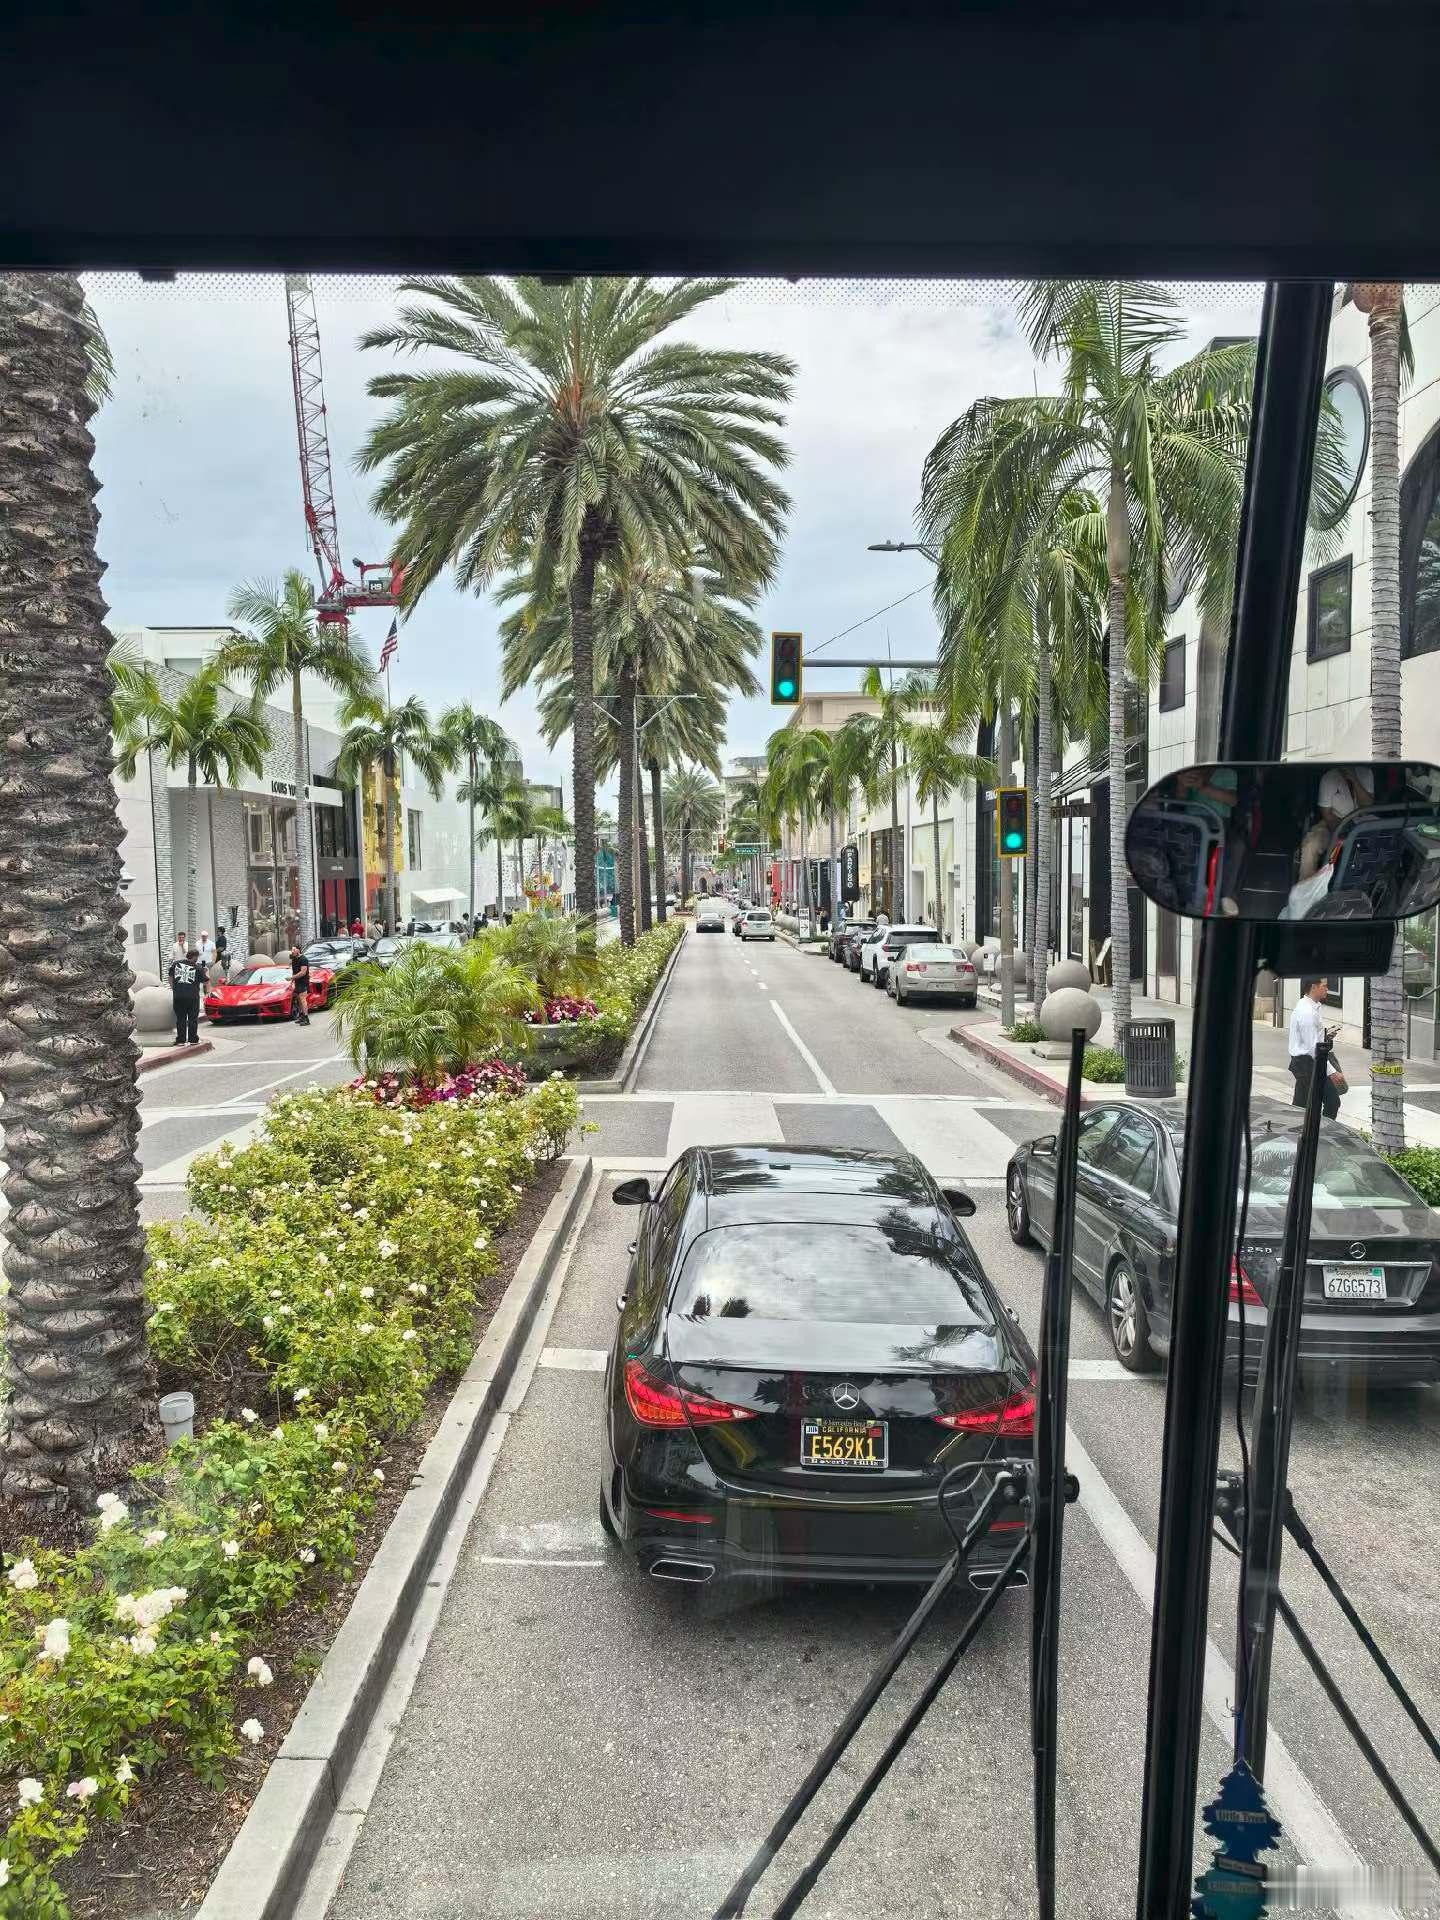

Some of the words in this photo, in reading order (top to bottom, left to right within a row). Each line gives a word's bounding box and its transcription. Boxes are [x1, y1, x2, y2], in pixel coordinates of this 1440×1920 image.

[1328, 1278, 1381, 1294] 6ZGG573
[822, 1426, 867, 1434] CALIFORNIA
[812, 1435, 874, 1460] E569K1
